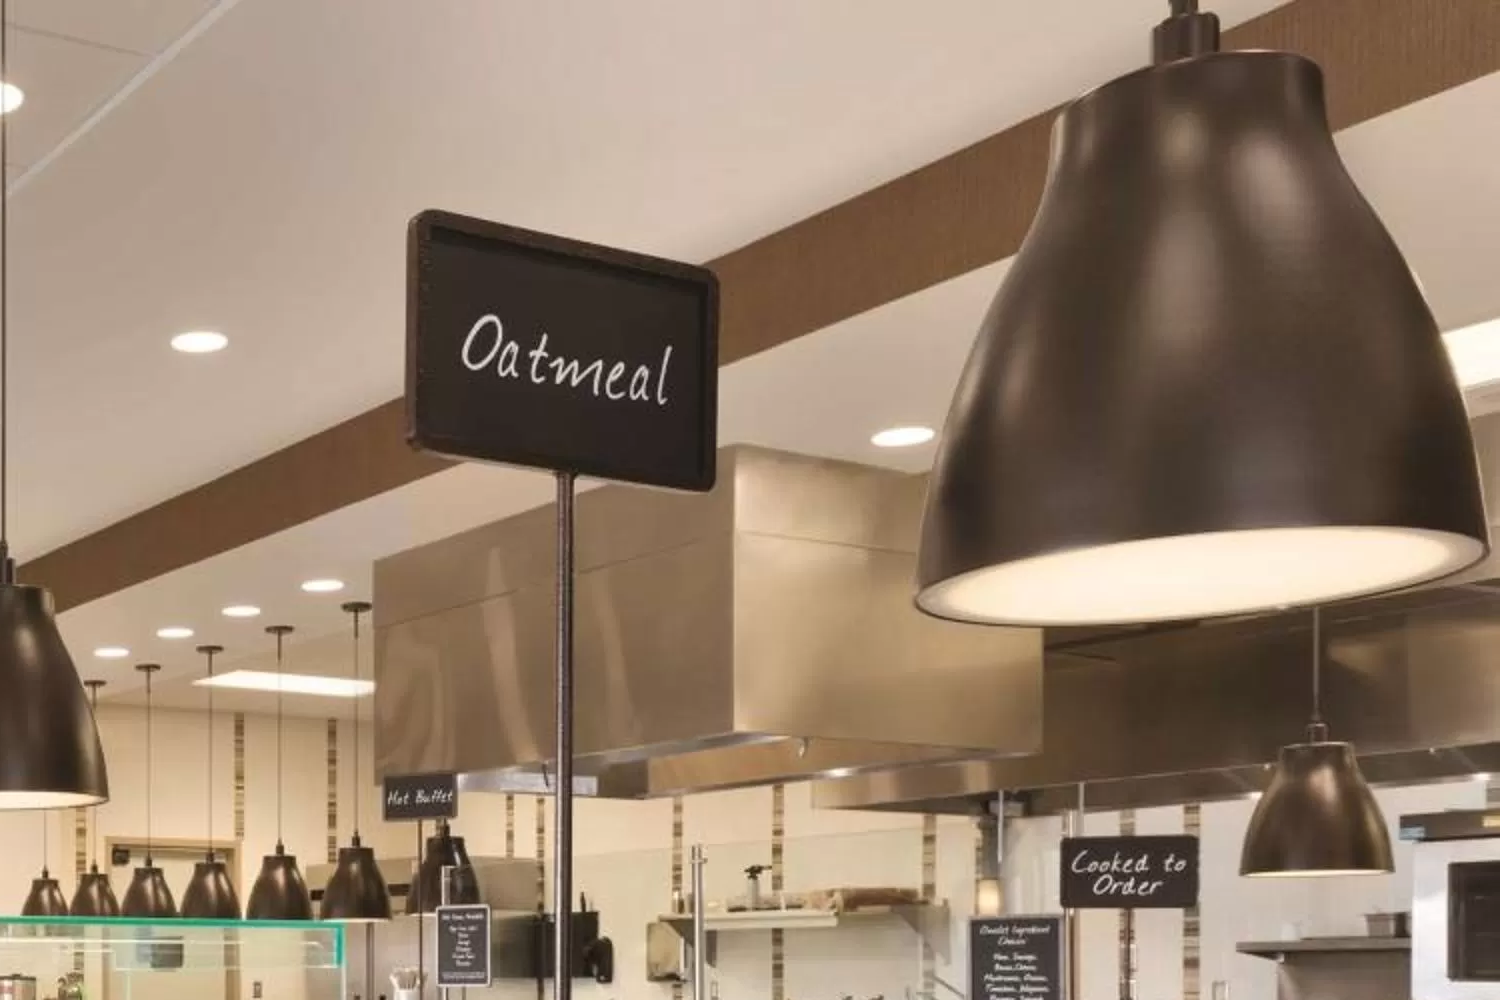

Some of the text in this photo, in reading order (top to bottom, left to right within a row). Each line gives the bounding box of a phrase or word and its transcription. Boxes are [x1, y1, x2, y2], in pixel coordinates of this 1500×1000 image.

[461, 314, 673, 406] Oatmeal
[1070, 848, 1188, 874] Cooked to
[1092, 873, 1165, 897] Order
